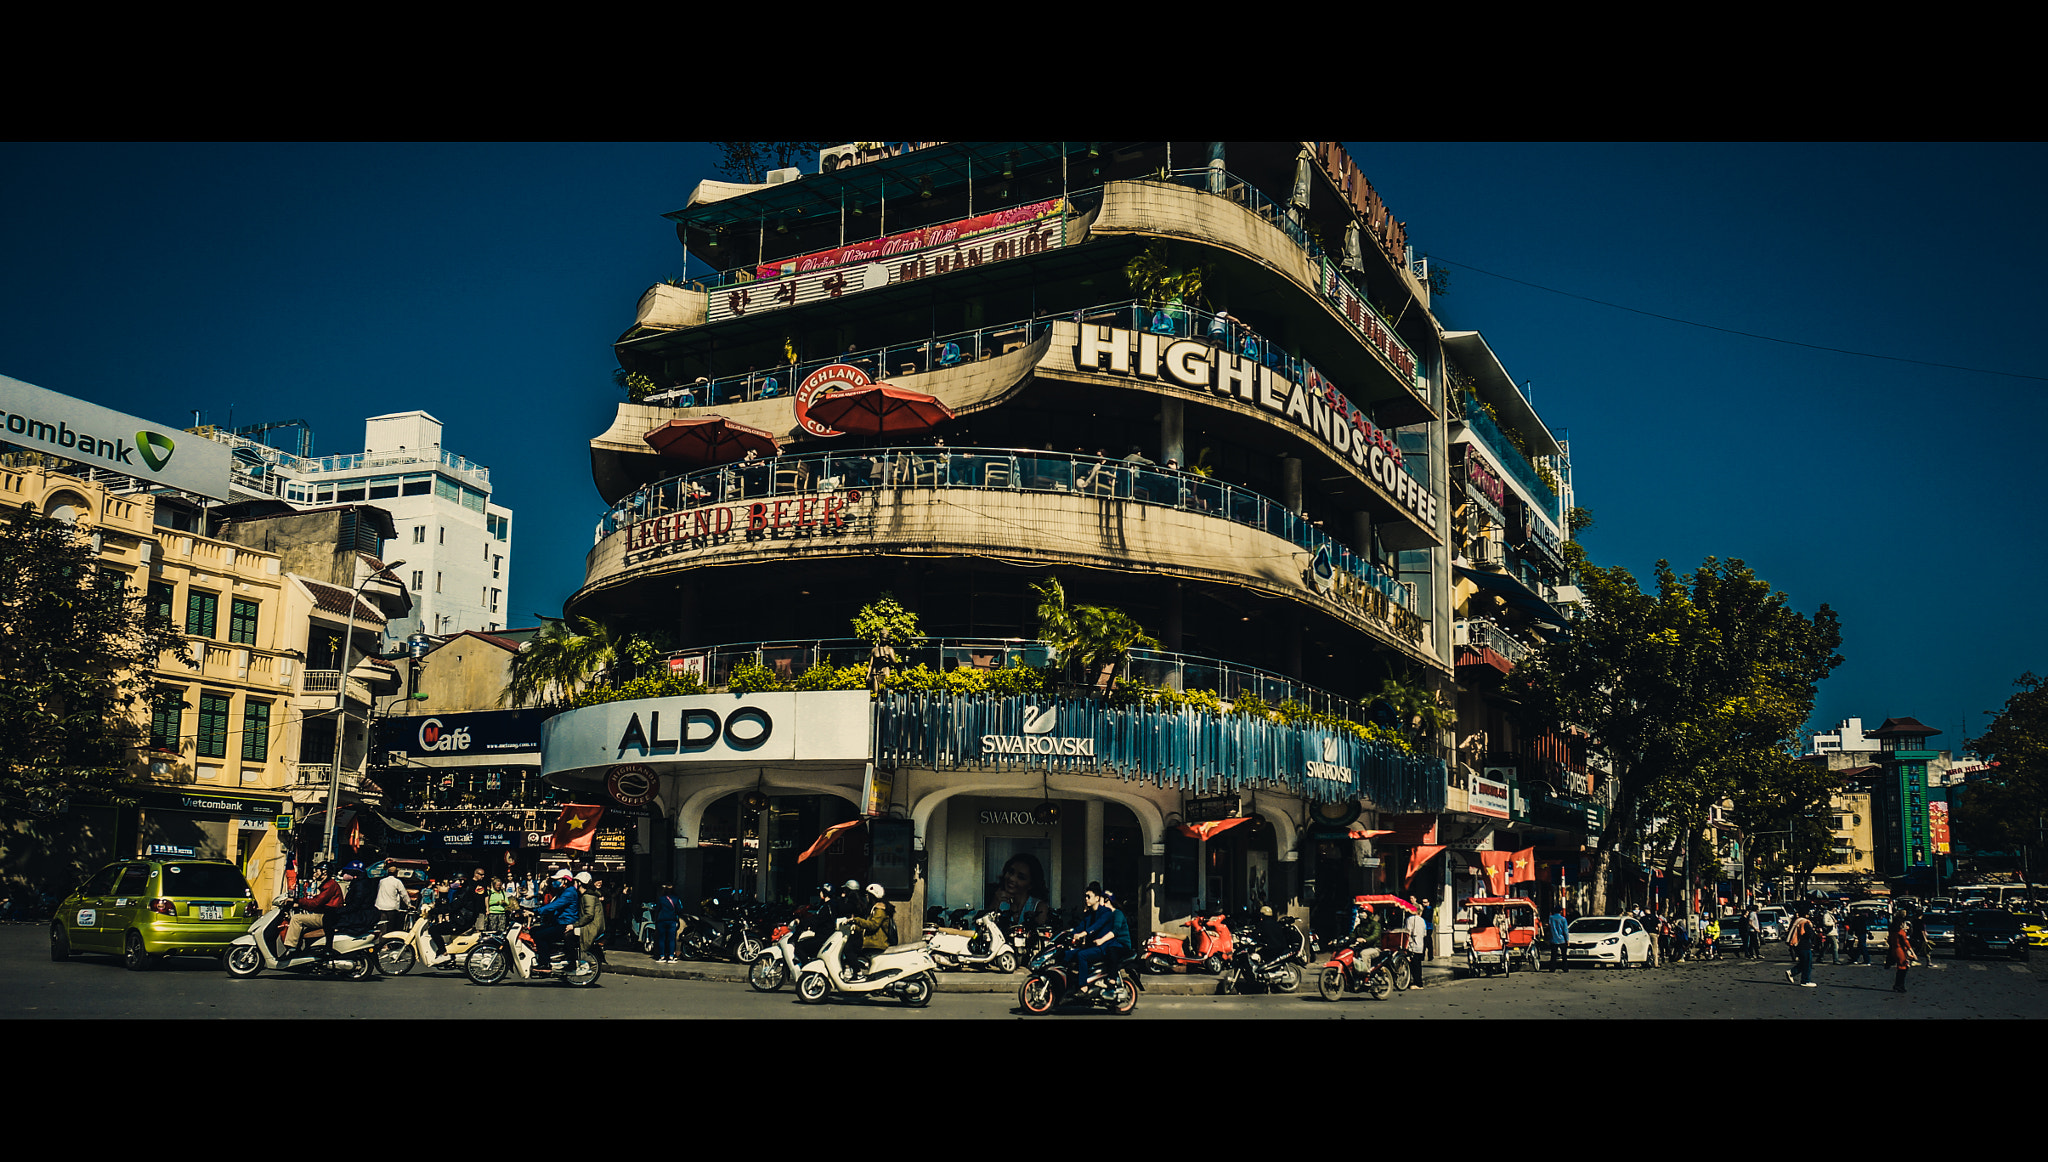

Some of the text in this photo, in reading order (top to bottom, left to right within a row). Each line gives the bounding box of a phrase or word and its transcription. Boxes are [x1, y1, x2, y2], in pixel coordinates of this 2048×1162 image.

[798, 367, 868, 403] HIGHLAND
[1080, 322, 1364, 466] HIGHLANDS
[1370, 445, 1437, 530] COFFEE
[625, 496, 844, 552] LEGEND BEER
[617, 706, 774, 752] ALDO
[982, 734, 1096, 757] SWAROVSKI
[611, 765, 657, 785] HIGHLANDS
[1306, 760, 1352, 784] SWAROVSKI
[181, 797, 244, 811] Vietcombank
[615, 792, 650, 805] COFFEE
[243, 819, 265, 828] ATM
[980, 810, 1058, 826] SWAROV
